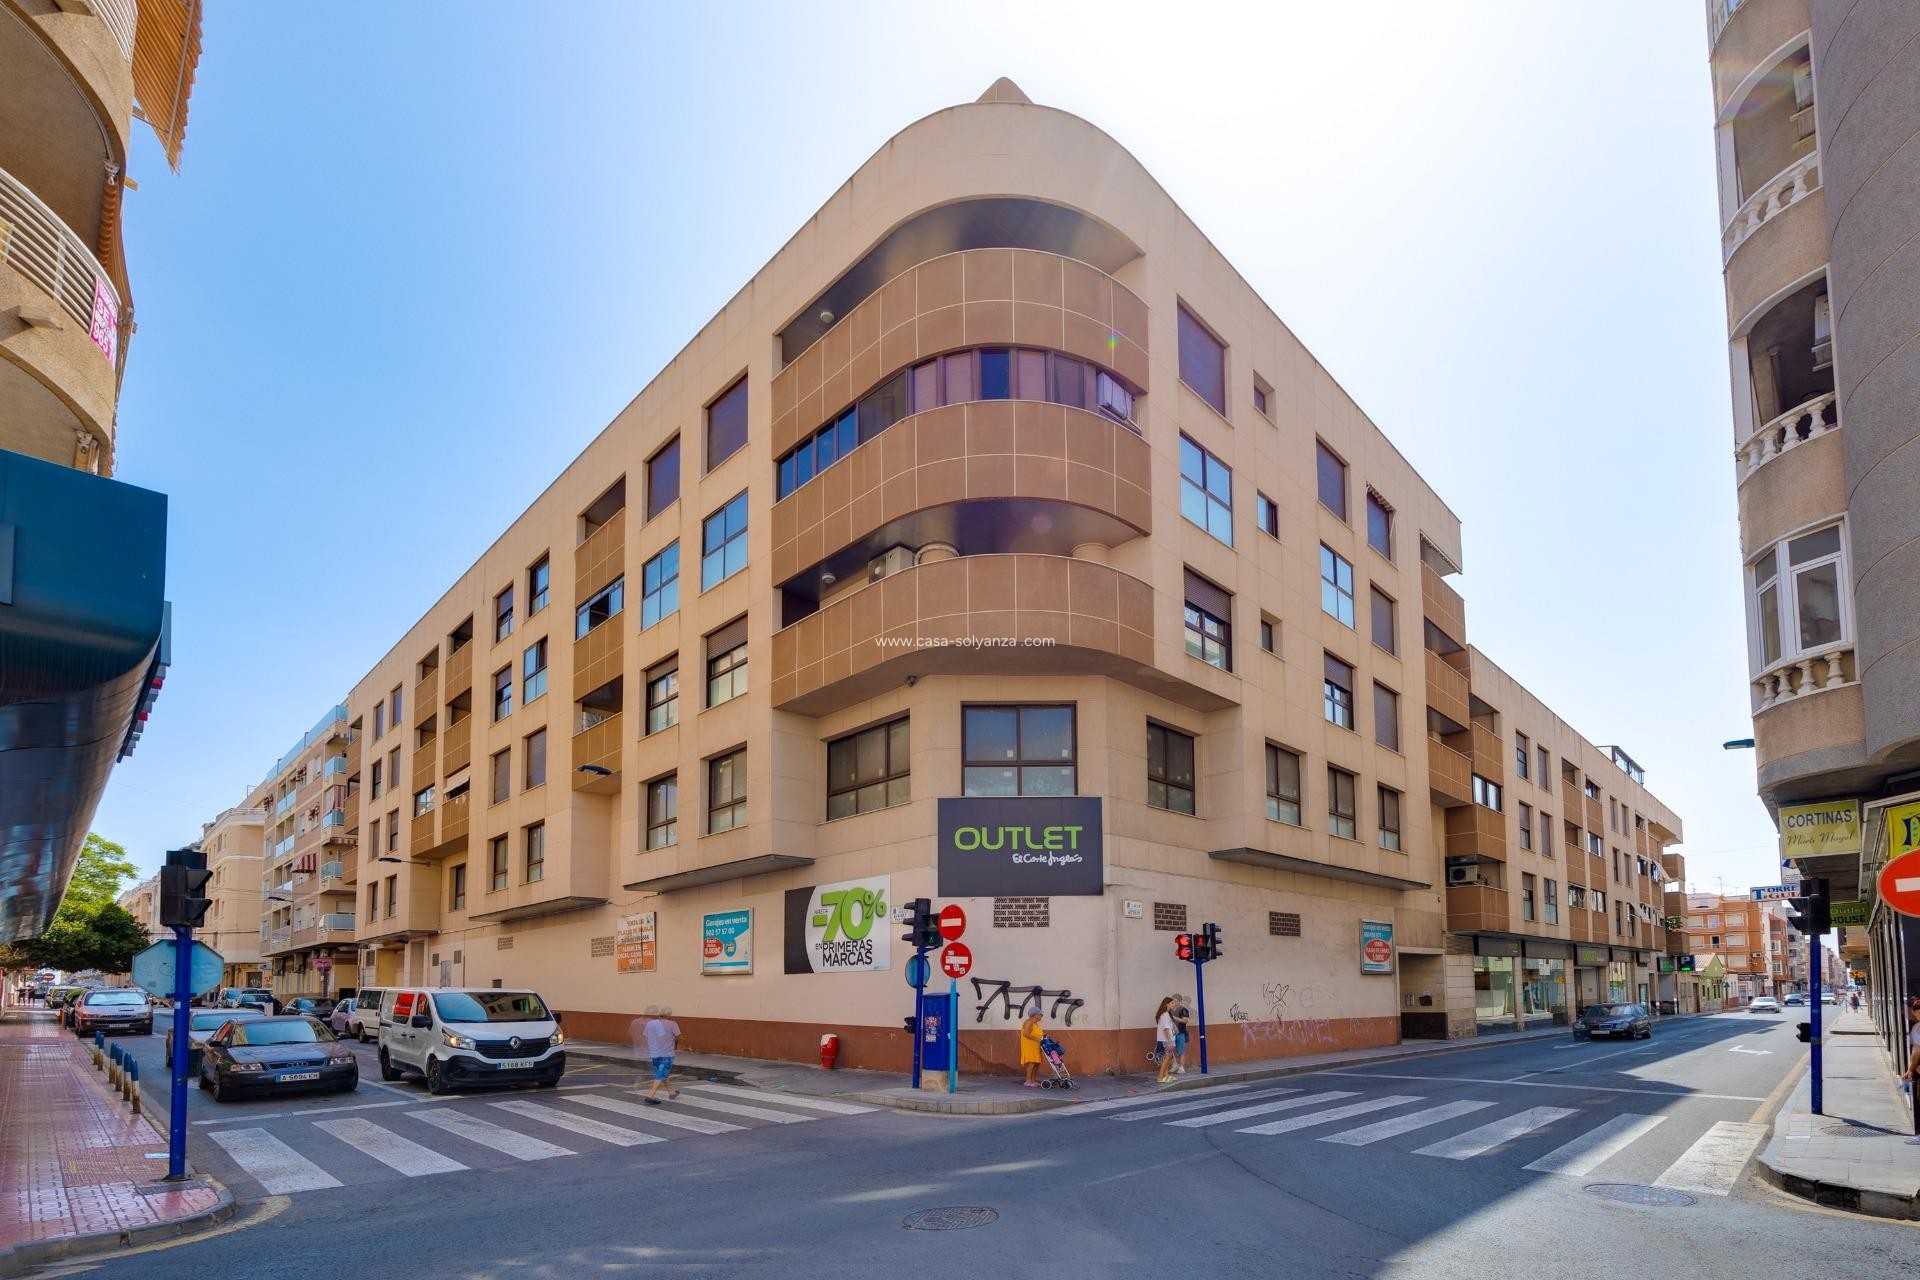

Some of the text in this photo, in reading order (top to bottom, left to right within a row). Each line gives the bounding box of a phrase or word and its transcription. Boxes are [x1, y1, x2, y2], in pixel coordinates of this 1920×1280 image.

[1787, 809, 1852, 828] CORTINAS
[954, 826, 1083, 850] OUTLET
[1012, 853, 1023, 863] El
[1023, 853, 1047, 863] Corte
[705, 919, 724, 927] Garajes
[732, 916, 747, 924] venta
[1830, 916, 1866, 925] HOUSE
[823, 939, 873, 953] PRIMERAS
[823, 951, 873, 967] MARCAS
